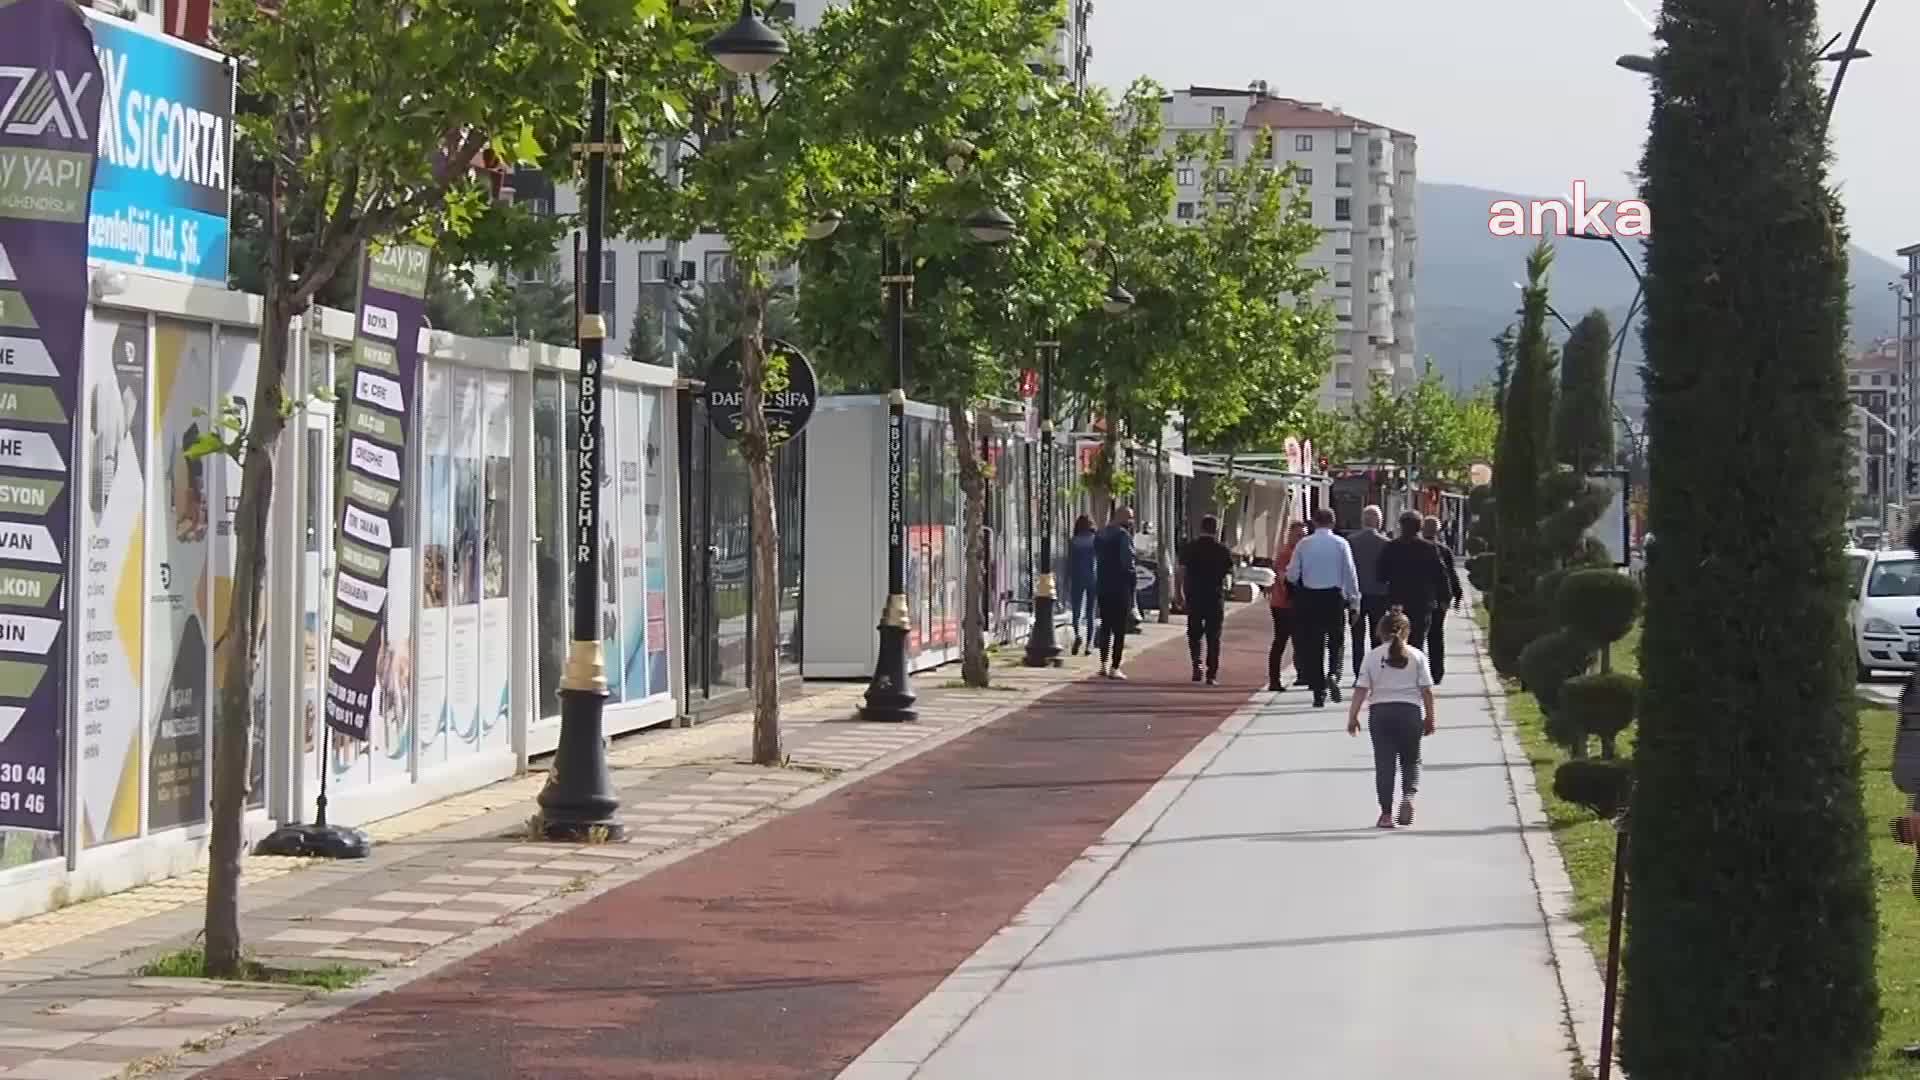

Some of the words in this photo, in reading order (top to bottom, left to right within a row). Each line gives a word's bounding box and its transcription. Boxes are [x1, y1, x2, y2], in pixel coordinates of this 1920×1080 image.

[23, 155, 83, 191] YAPI
[1, 763, 23, 783] 30
[26, 765, 46, 785] 44
[0, 791, 20, 811] 91
[24, 793, 46, 814] 46
